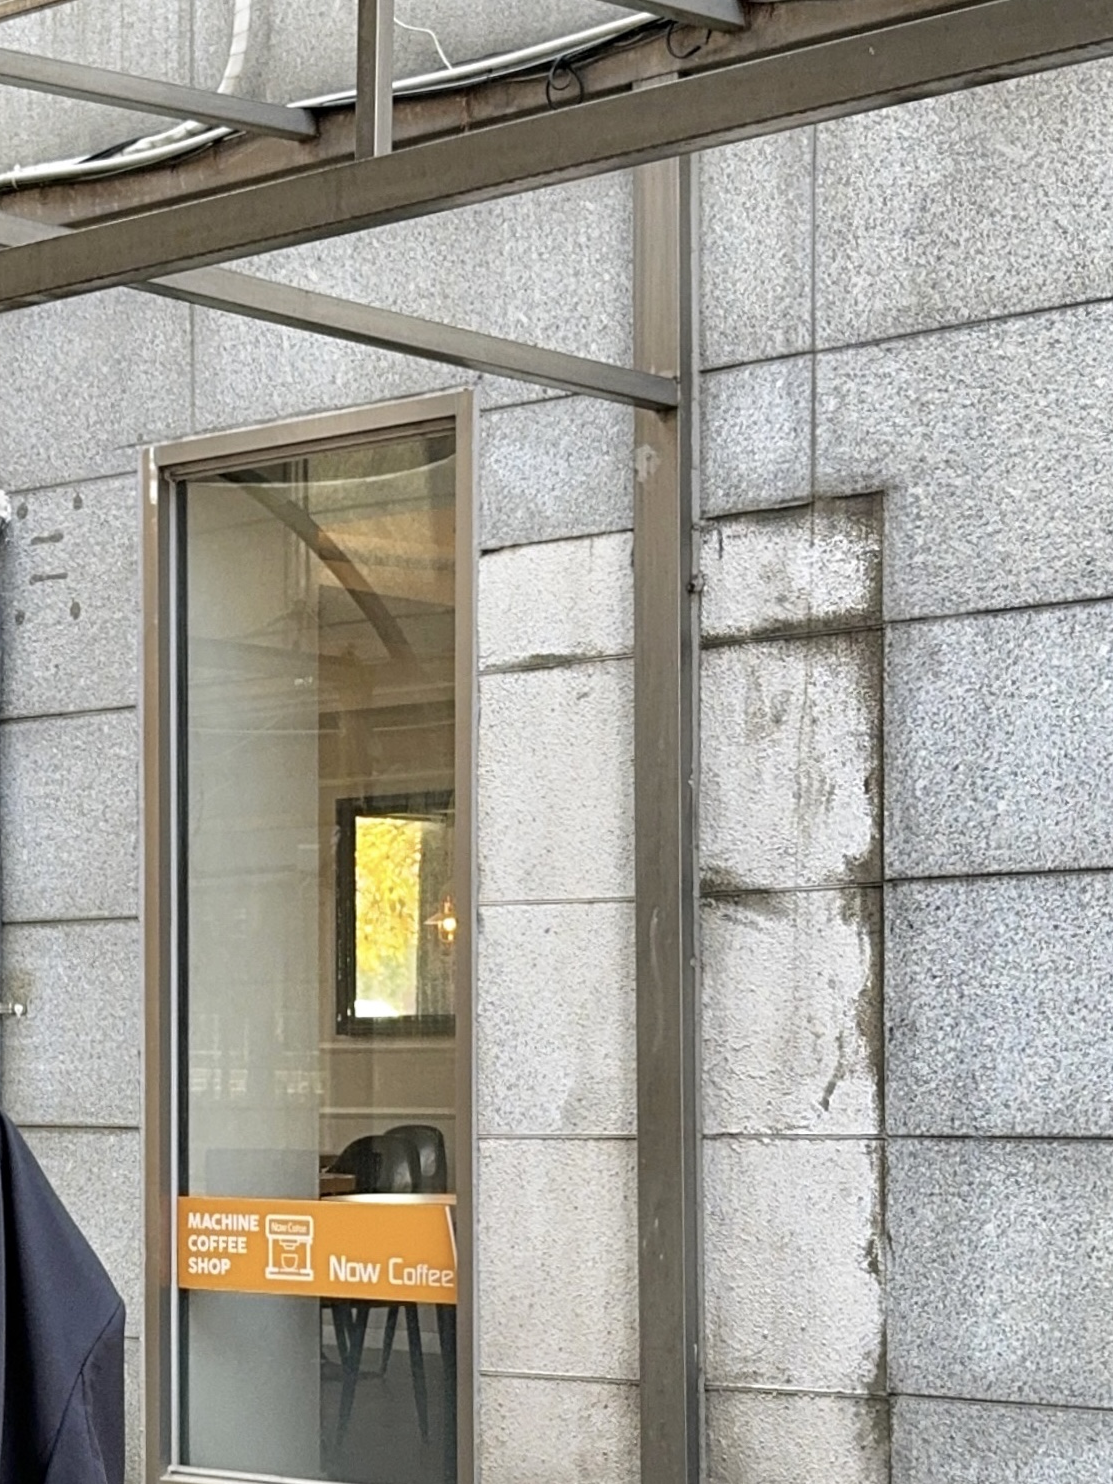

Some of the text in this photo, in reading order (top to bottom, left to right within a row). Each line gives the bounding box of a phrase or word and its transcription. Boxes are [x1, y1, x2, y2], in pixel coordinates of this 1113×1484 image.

[187, 1212, 260, 1232] MACHINE
[187, 1235, 247, 1254] COFFEE
[187, 1257, 231, 1275] SHOP
[328, 1255, 455, 1287] Now Coffee
